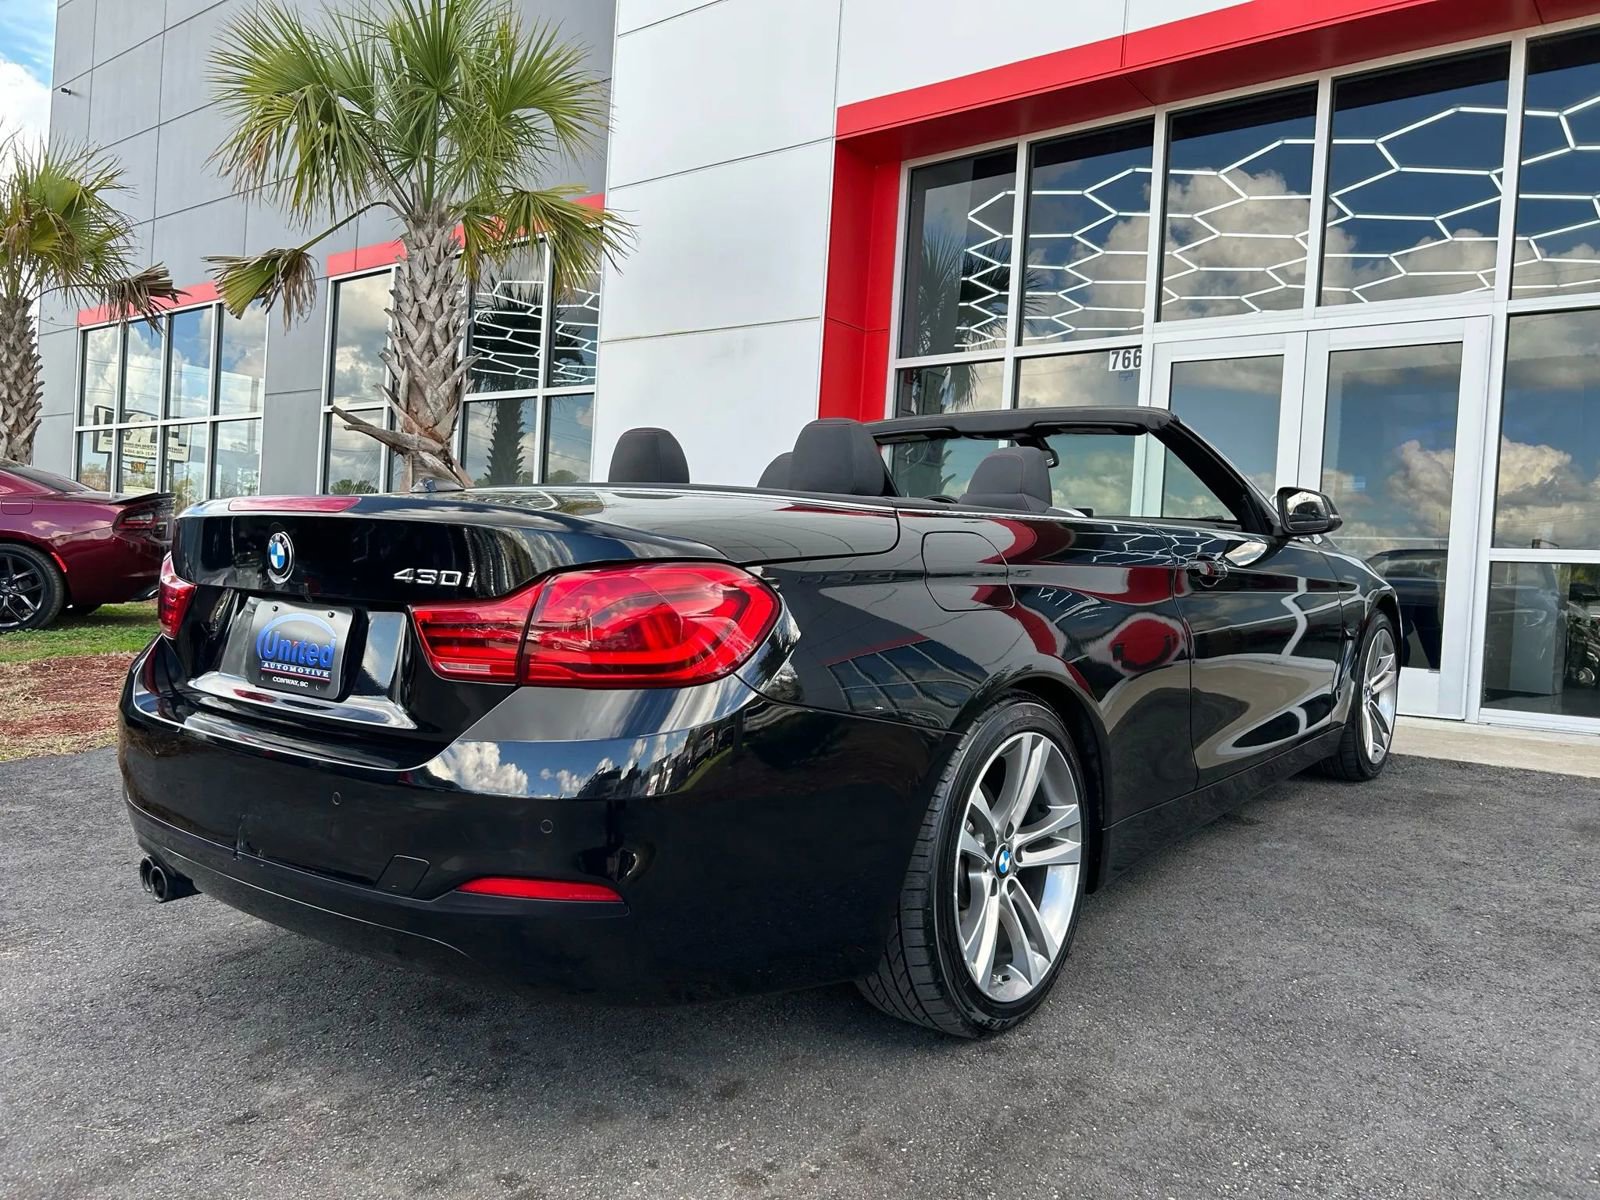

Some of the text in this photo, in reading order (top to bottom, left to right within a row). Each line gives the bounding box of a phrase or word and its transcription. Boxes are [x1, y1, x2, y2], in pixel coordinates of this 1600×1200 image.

[1111, 349, 1142, 370] 766
[393, 568, 476, 588] 430i
[263, 631, 336, 669] United
[263, 662, 330, 678] AUTOMOTIVE
